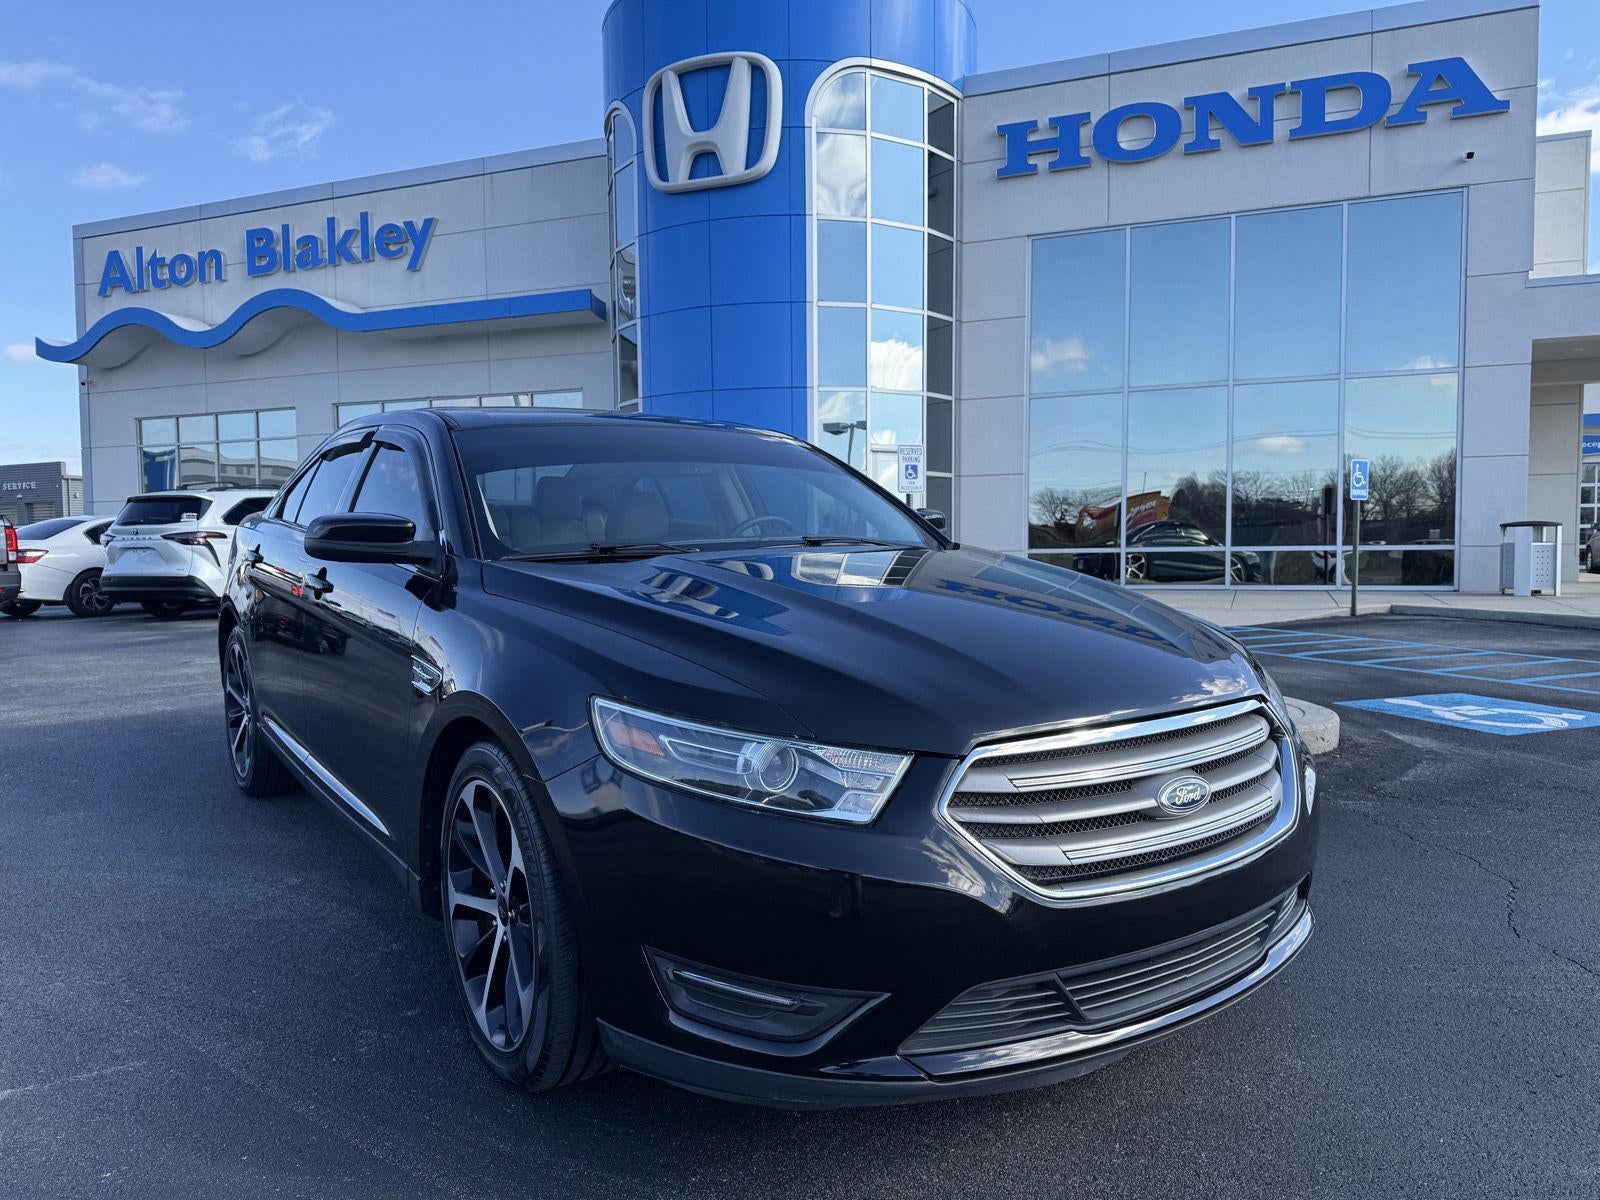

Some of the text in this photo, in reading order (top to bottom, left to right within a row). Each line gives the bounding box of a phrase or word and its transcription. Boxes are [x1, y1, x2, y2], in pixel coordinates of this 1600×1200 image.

[996, 56, 1511, 179] HONDA
[98, 211, 437, 297] Alton Blakley
[900, 447, 922, 455] RESERVED
[2, 481, 37, 491] SERVICE
[1175, 784, 1201, 805] Ford
